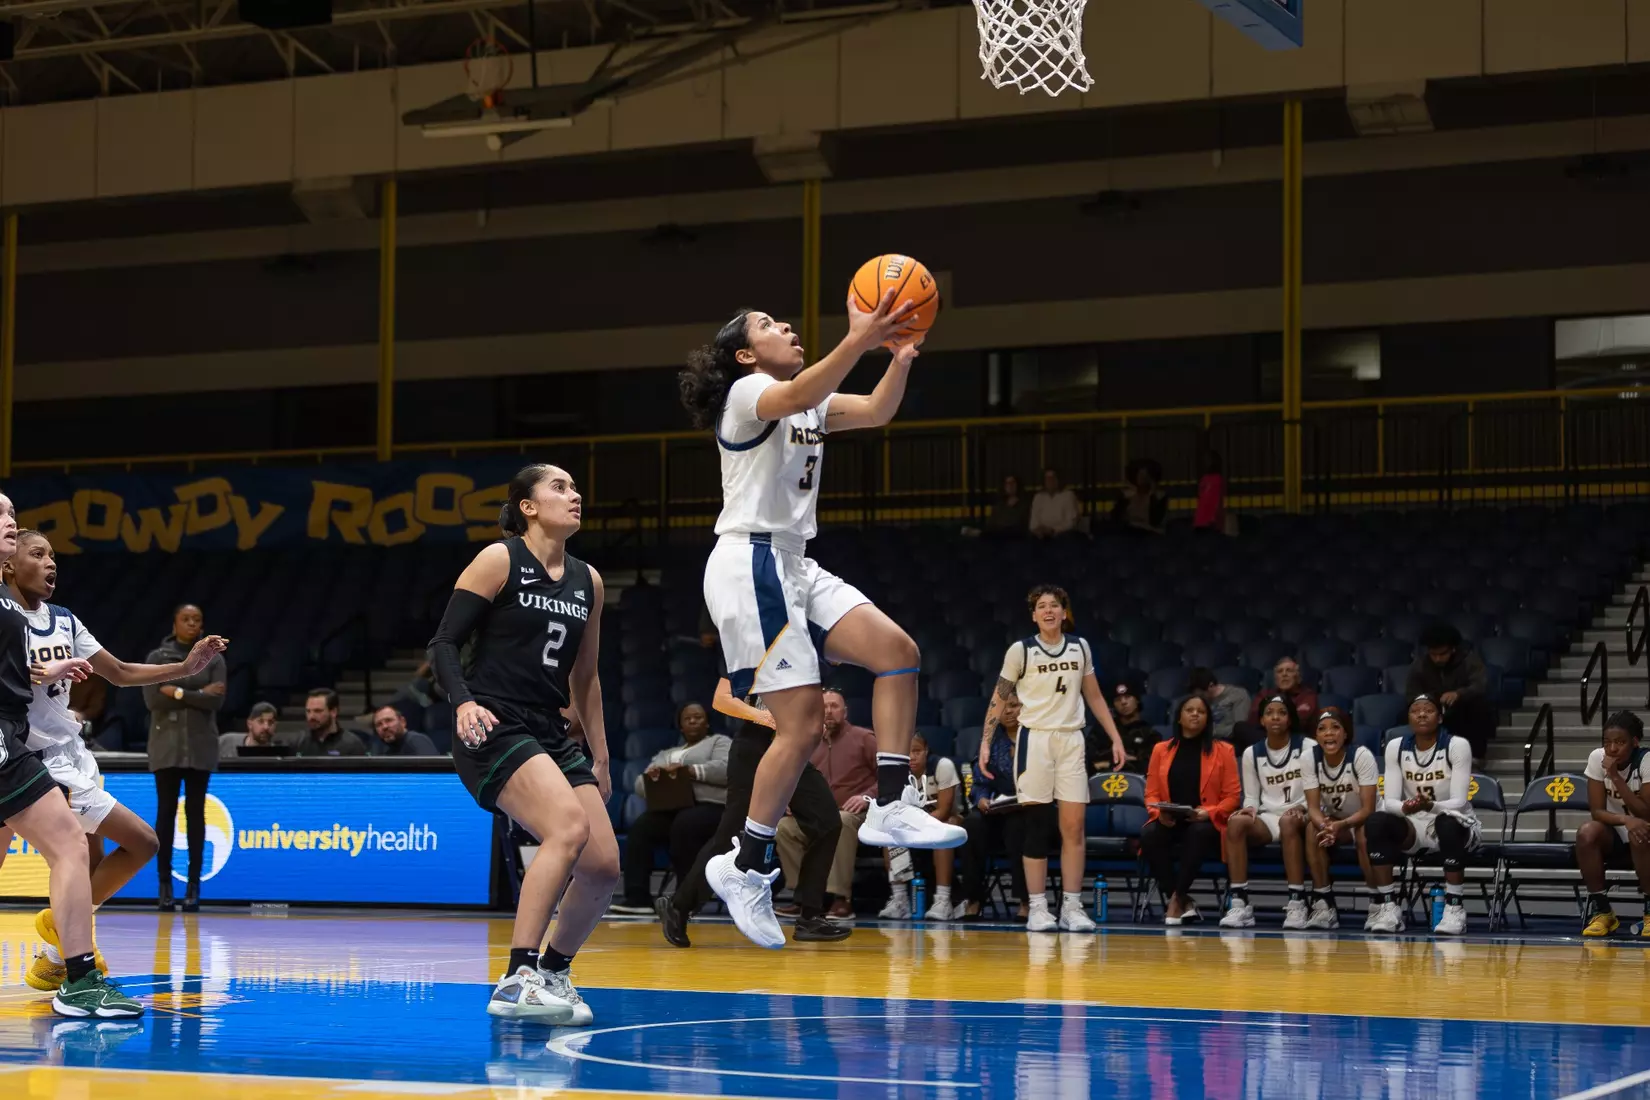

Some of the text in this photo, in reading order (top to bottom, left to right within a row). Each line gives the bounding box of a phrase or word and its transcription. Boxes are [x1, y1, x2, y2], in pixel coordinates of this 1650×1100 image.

[799, 455, 818, 490] 3
[16, 473, 510, 555] ROWDY ROOS
[520, 566, 535, 574] BLM
[518, 592, 589, 622] VIKINGS
[542, 620, 568, 668] 2
[1037, 661, 1080, 674] ROOS
[1055, 676, 1067, 695] 4
[1266, 768, 1302, 785] ROOS
[1405, 770, 1445, 782] ROOS
[1319, 783, 1353, 794] ROOS
